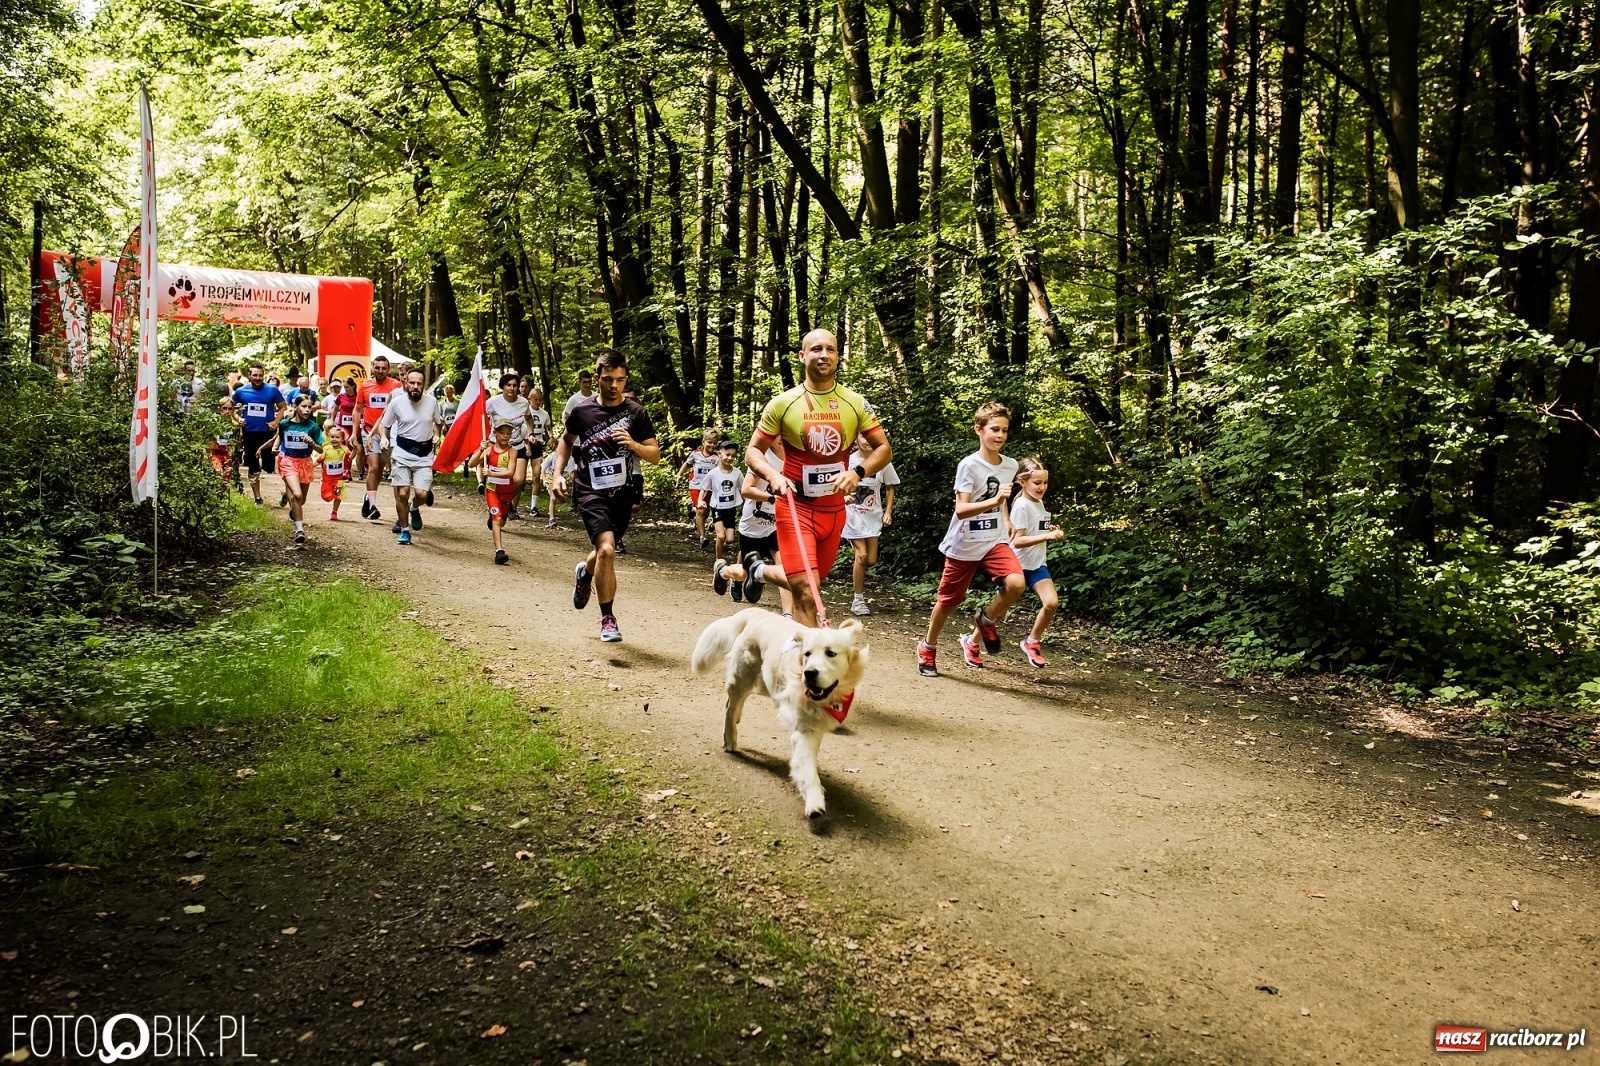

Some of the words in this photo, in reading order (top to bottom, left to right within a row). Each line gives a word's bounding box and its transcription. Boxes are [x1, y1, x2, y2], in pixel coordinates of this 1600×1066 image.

[803, 412, 841, 421] RACIBORKI
[601, 465, 615, 475] 33
[817, 473, 832, 483] 80
[977, 520, 991, 530] 15
